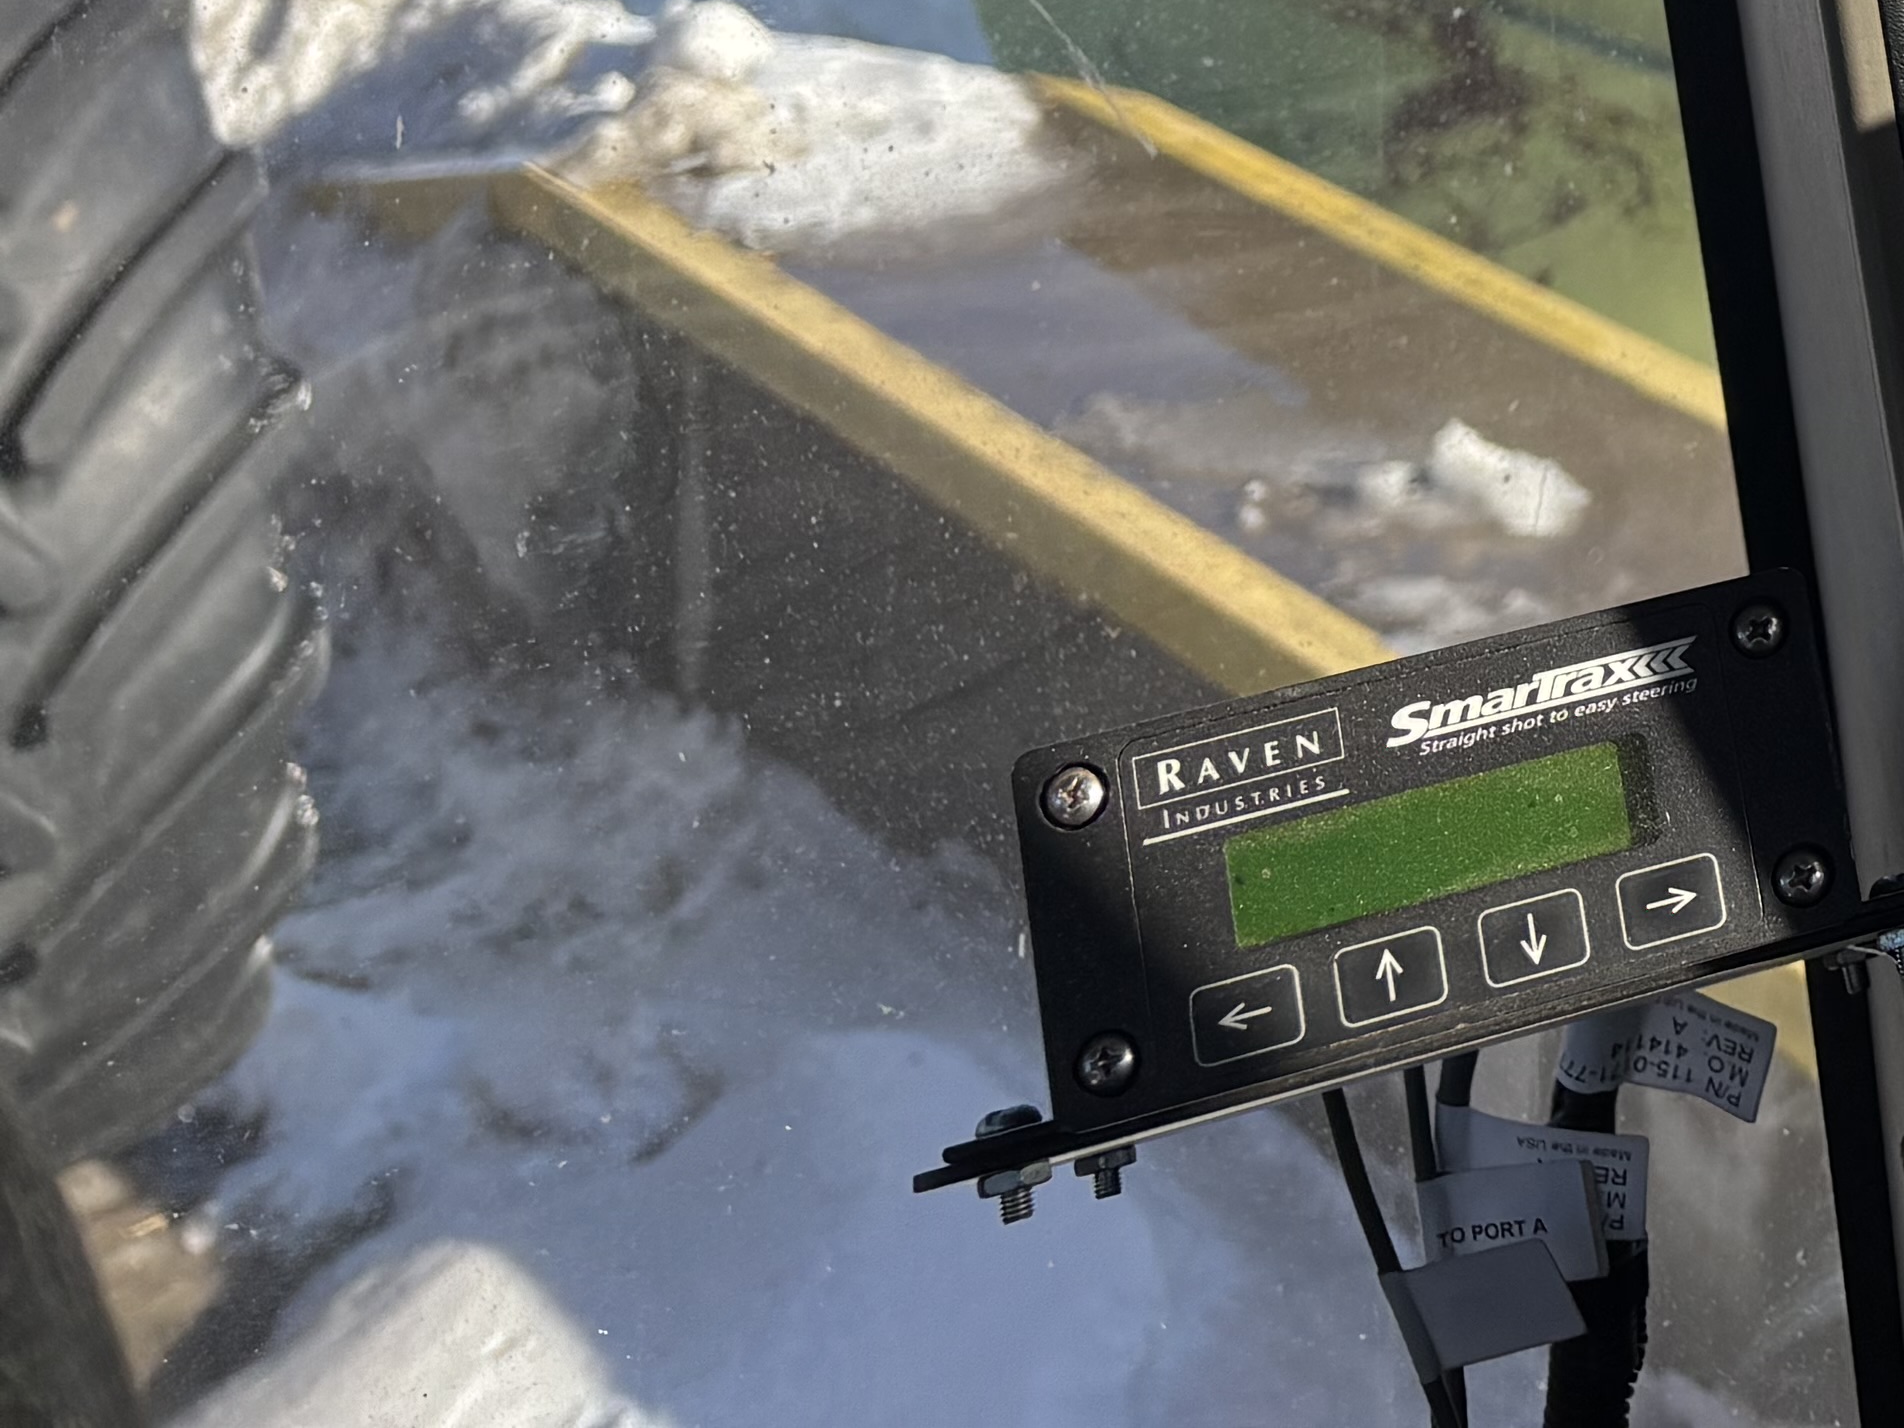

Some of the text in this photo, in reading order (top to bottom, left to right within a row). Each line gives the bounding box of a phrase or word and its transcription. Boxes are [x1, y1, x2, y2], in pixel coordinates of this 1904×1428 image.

[1419, 676, 1698, 756] Straight shot to easy steering
[1156, 730, 1322, 796] RAVEN
[1162, 775, 1327, 829] INDUSTRIES
[1671, 1016, 1755, 1064] REV: A
[1705, 1075, 1742, 1108] P/N
[1516, 1136, 1546, 1151] USA
[1593, 1166, 1628, 1187] RE
[1436, 1217, 1549, 1247] TO PORT A
